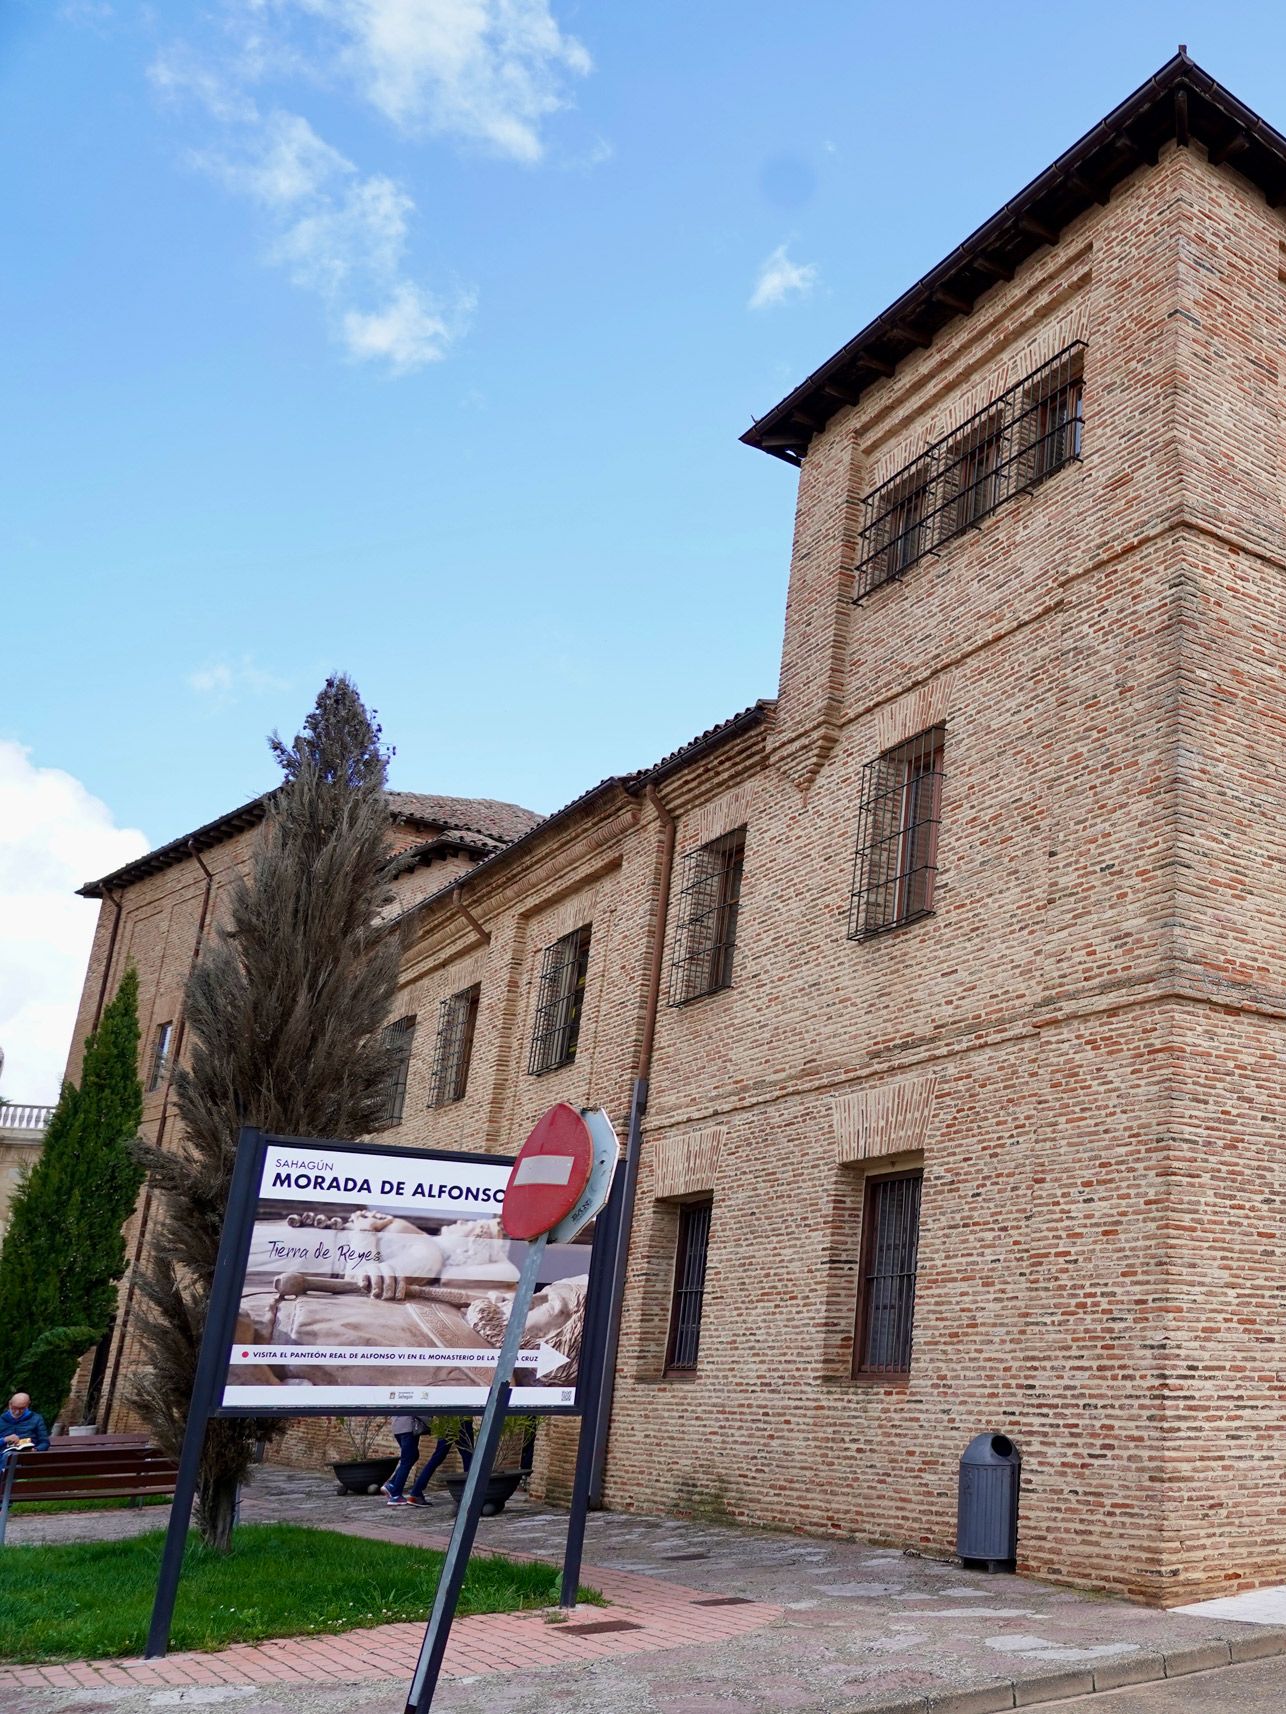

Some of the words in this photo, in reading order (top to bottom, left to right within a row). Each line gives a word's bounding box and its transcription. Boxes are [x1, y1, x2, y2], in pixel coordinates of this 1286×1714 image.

[275, 1159, 334, 1171] SAHAGÚN
[272, 1172, 372, 1194] MORADA
[380, 1180, 405, 1196] DE
[411, 1183, 506, 1203] ALFONSO
[268, 1240, 309, 1259] Tierra
[314, 1241, 332, 1260] de
[337, 1244, 383, 1270] Reyes
[290, 1351, 327, 1359] PANTEÓN
